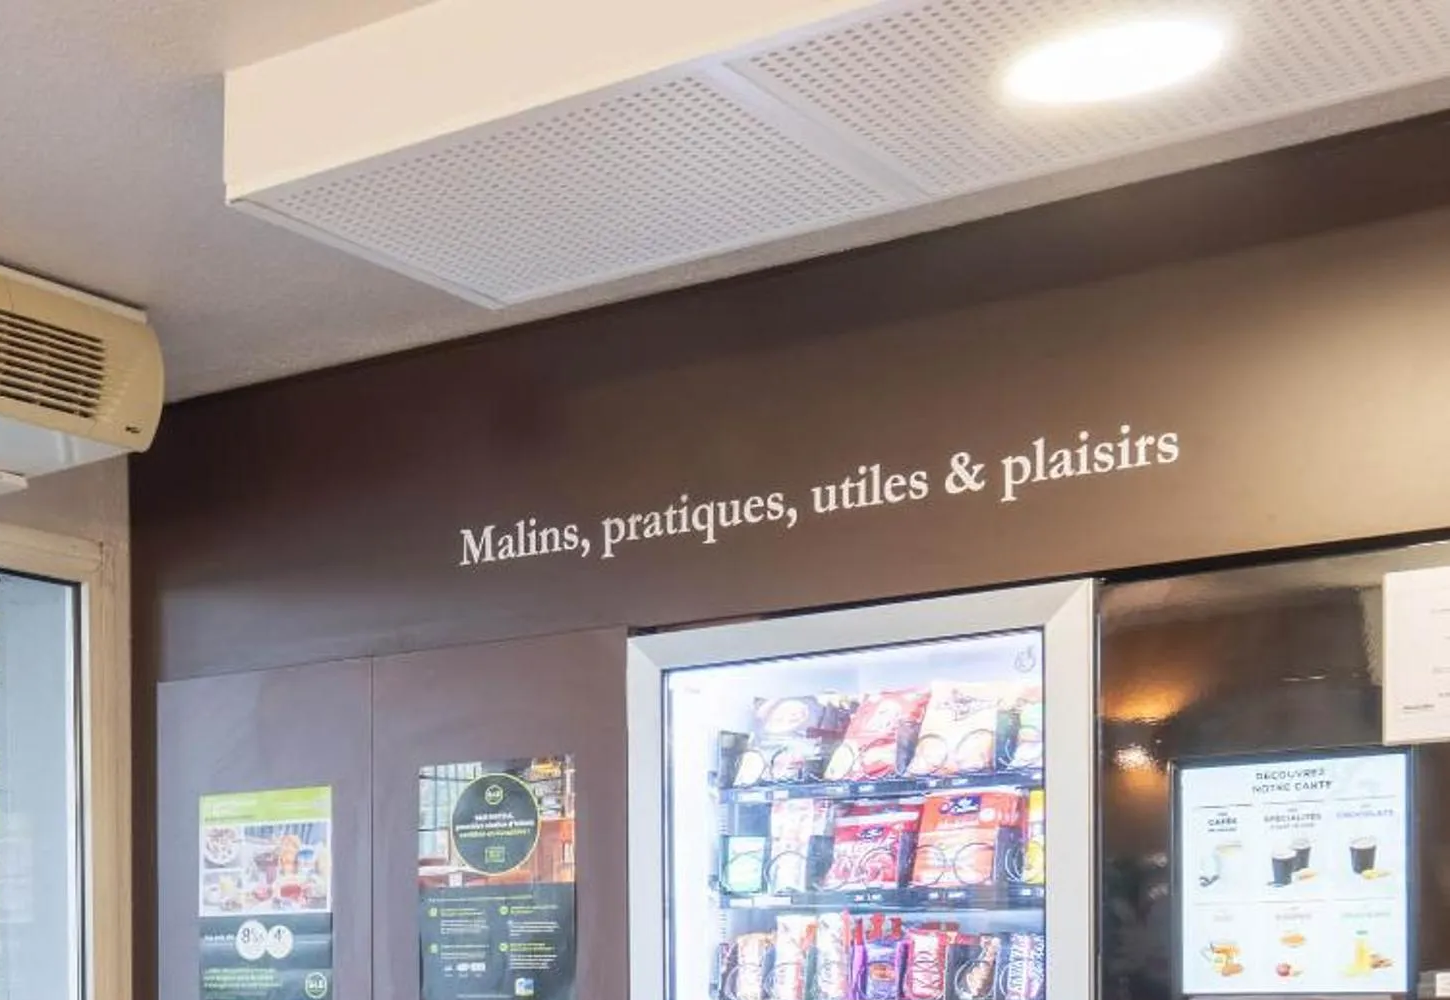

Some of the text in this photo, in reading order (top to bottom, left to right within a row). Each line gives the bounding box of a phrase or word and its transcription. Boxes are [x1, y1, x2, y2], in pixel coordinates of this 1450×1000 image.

[459, 423, 1180, 567] Malins, pratiques, utiles & plaisirs
